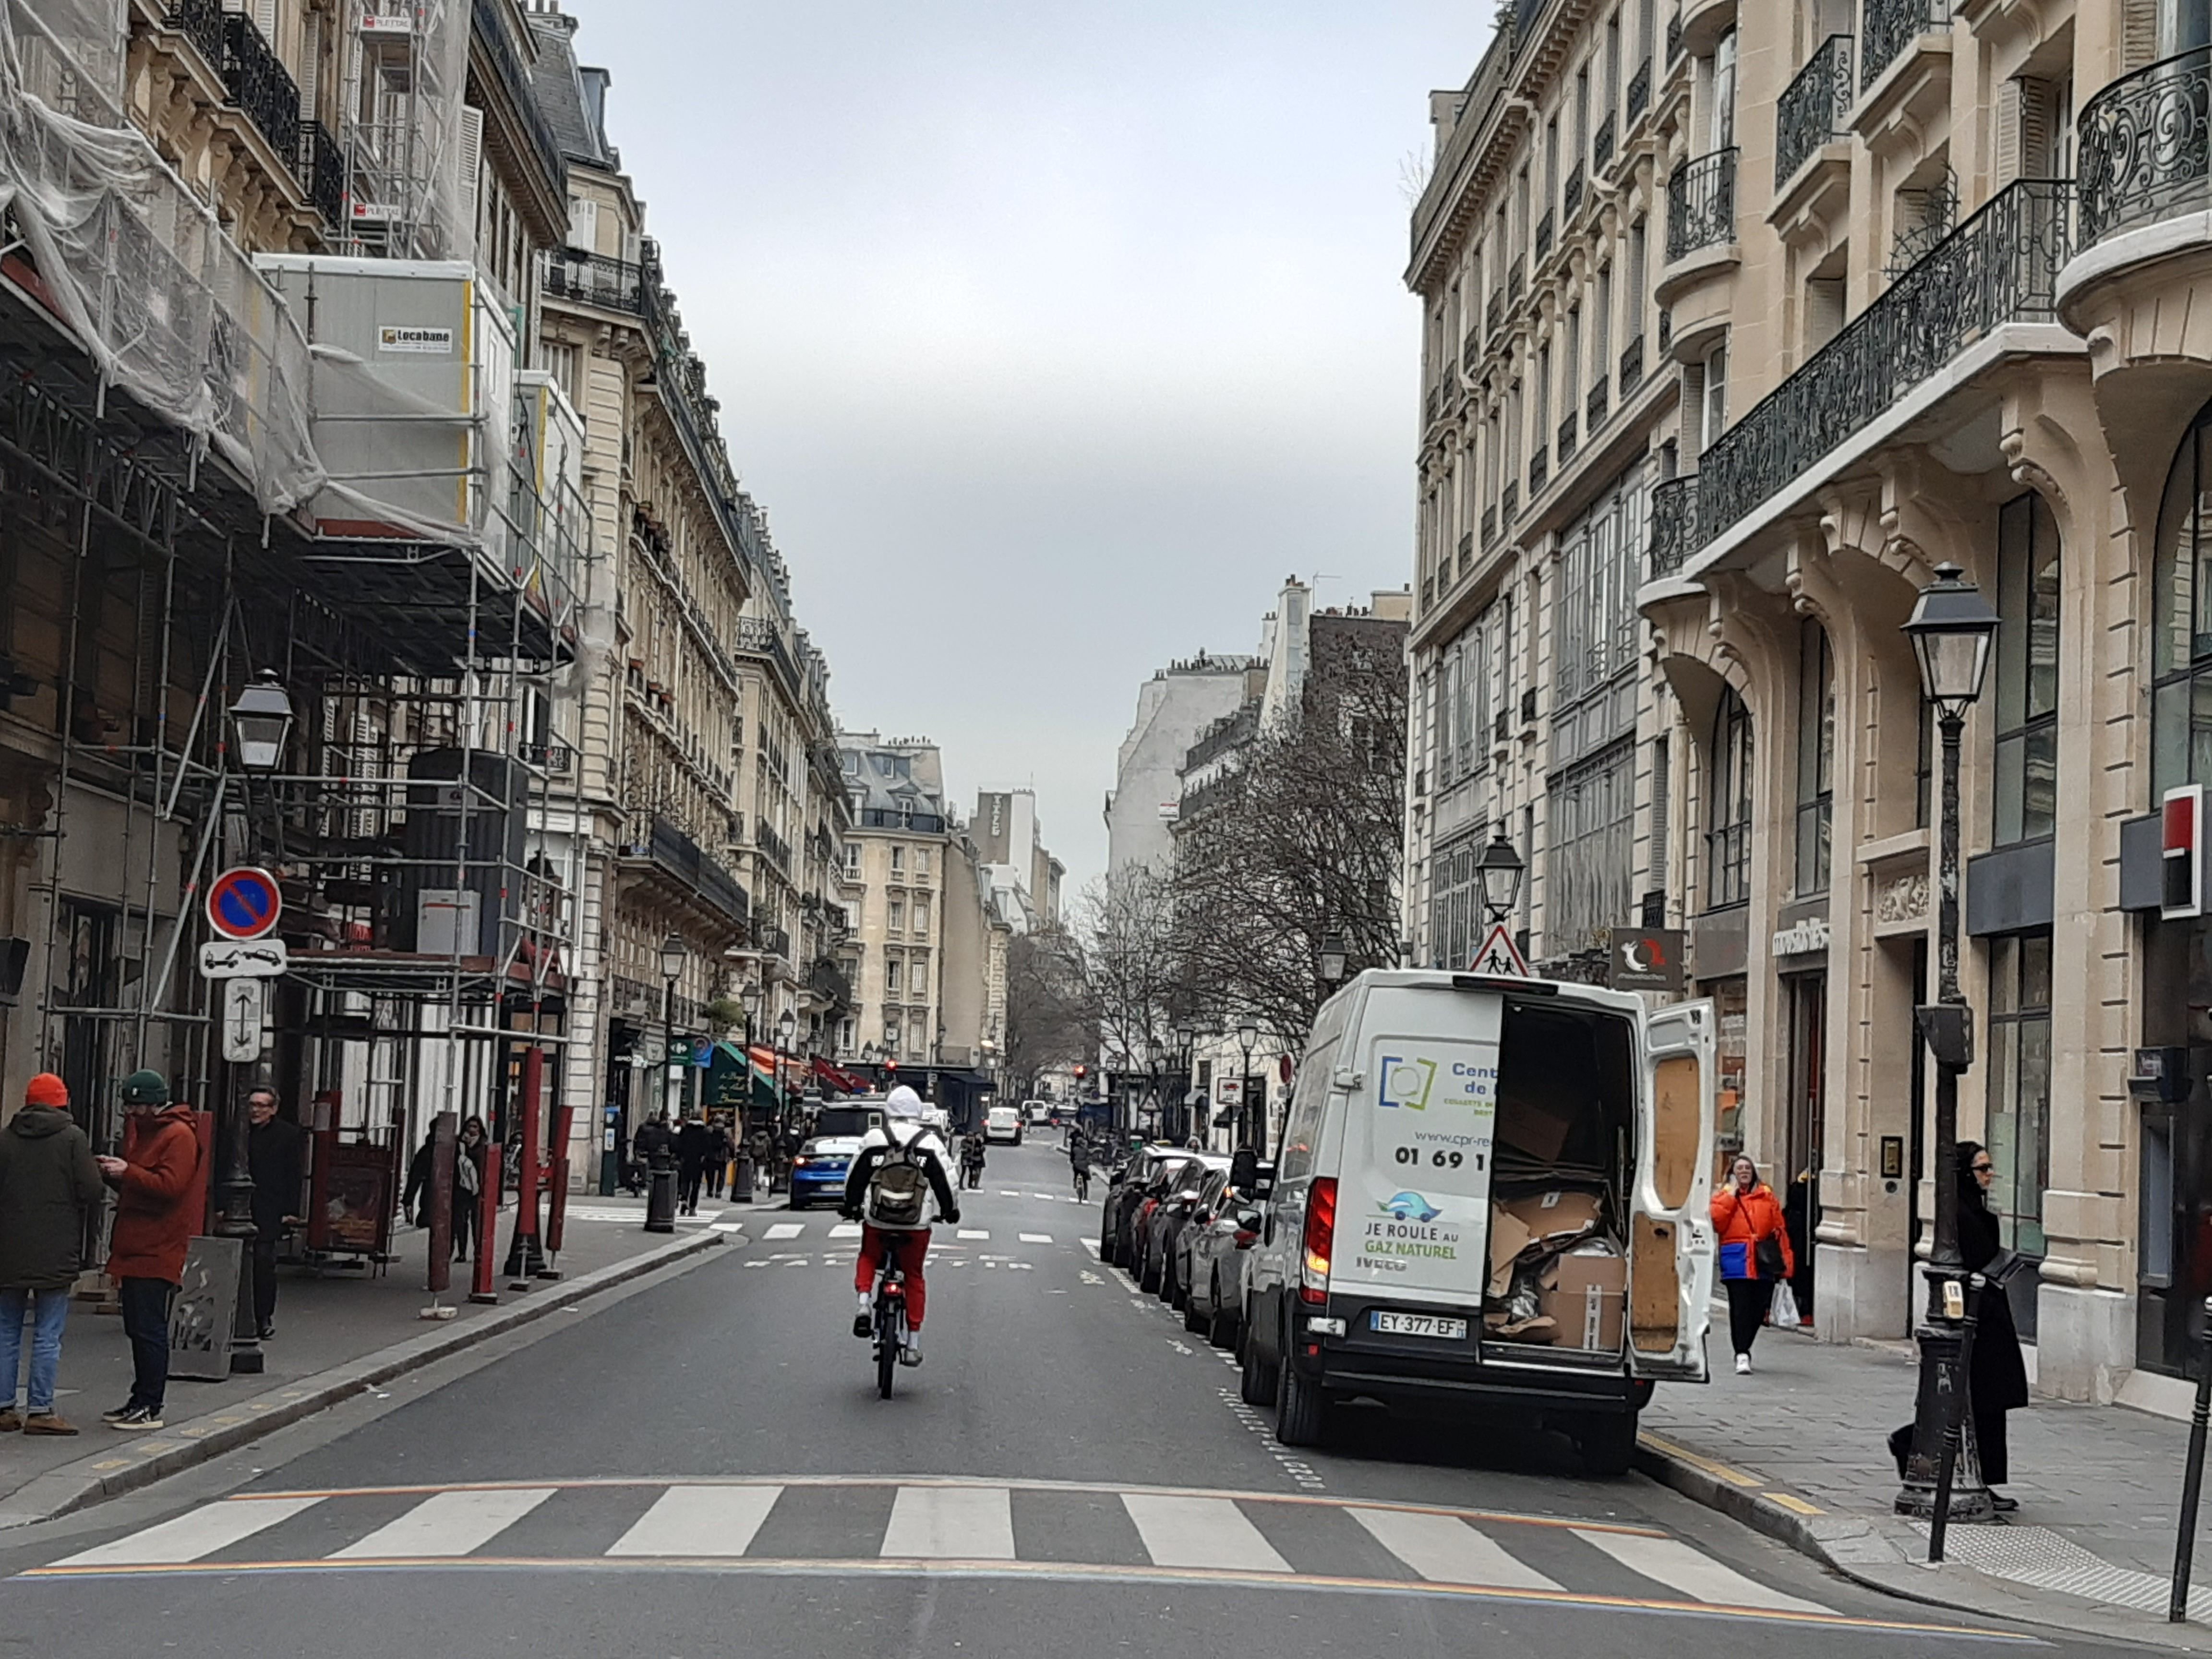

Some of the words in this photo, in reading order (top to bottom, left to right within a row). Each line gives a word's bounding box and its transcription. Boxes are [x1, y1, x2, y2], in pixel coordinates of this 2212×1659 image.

[1415, 1131, 1492, 1148] www.cpr-re
[1395, 1146, 1419, 1165] 01
[1432, 1150, 1463, 1168] 69
[1365, 1222, 1382, 1236] JE
[1387, 1224, 1438, 1240] ROULE
[1443, 1233, 1459, 1242] AU
[1365, 1239, 1394, 1254] GAZ
[1396, 1242, 1457, 1260] NATUREL
[1356, 1256, 1407, 1271] IVECO
